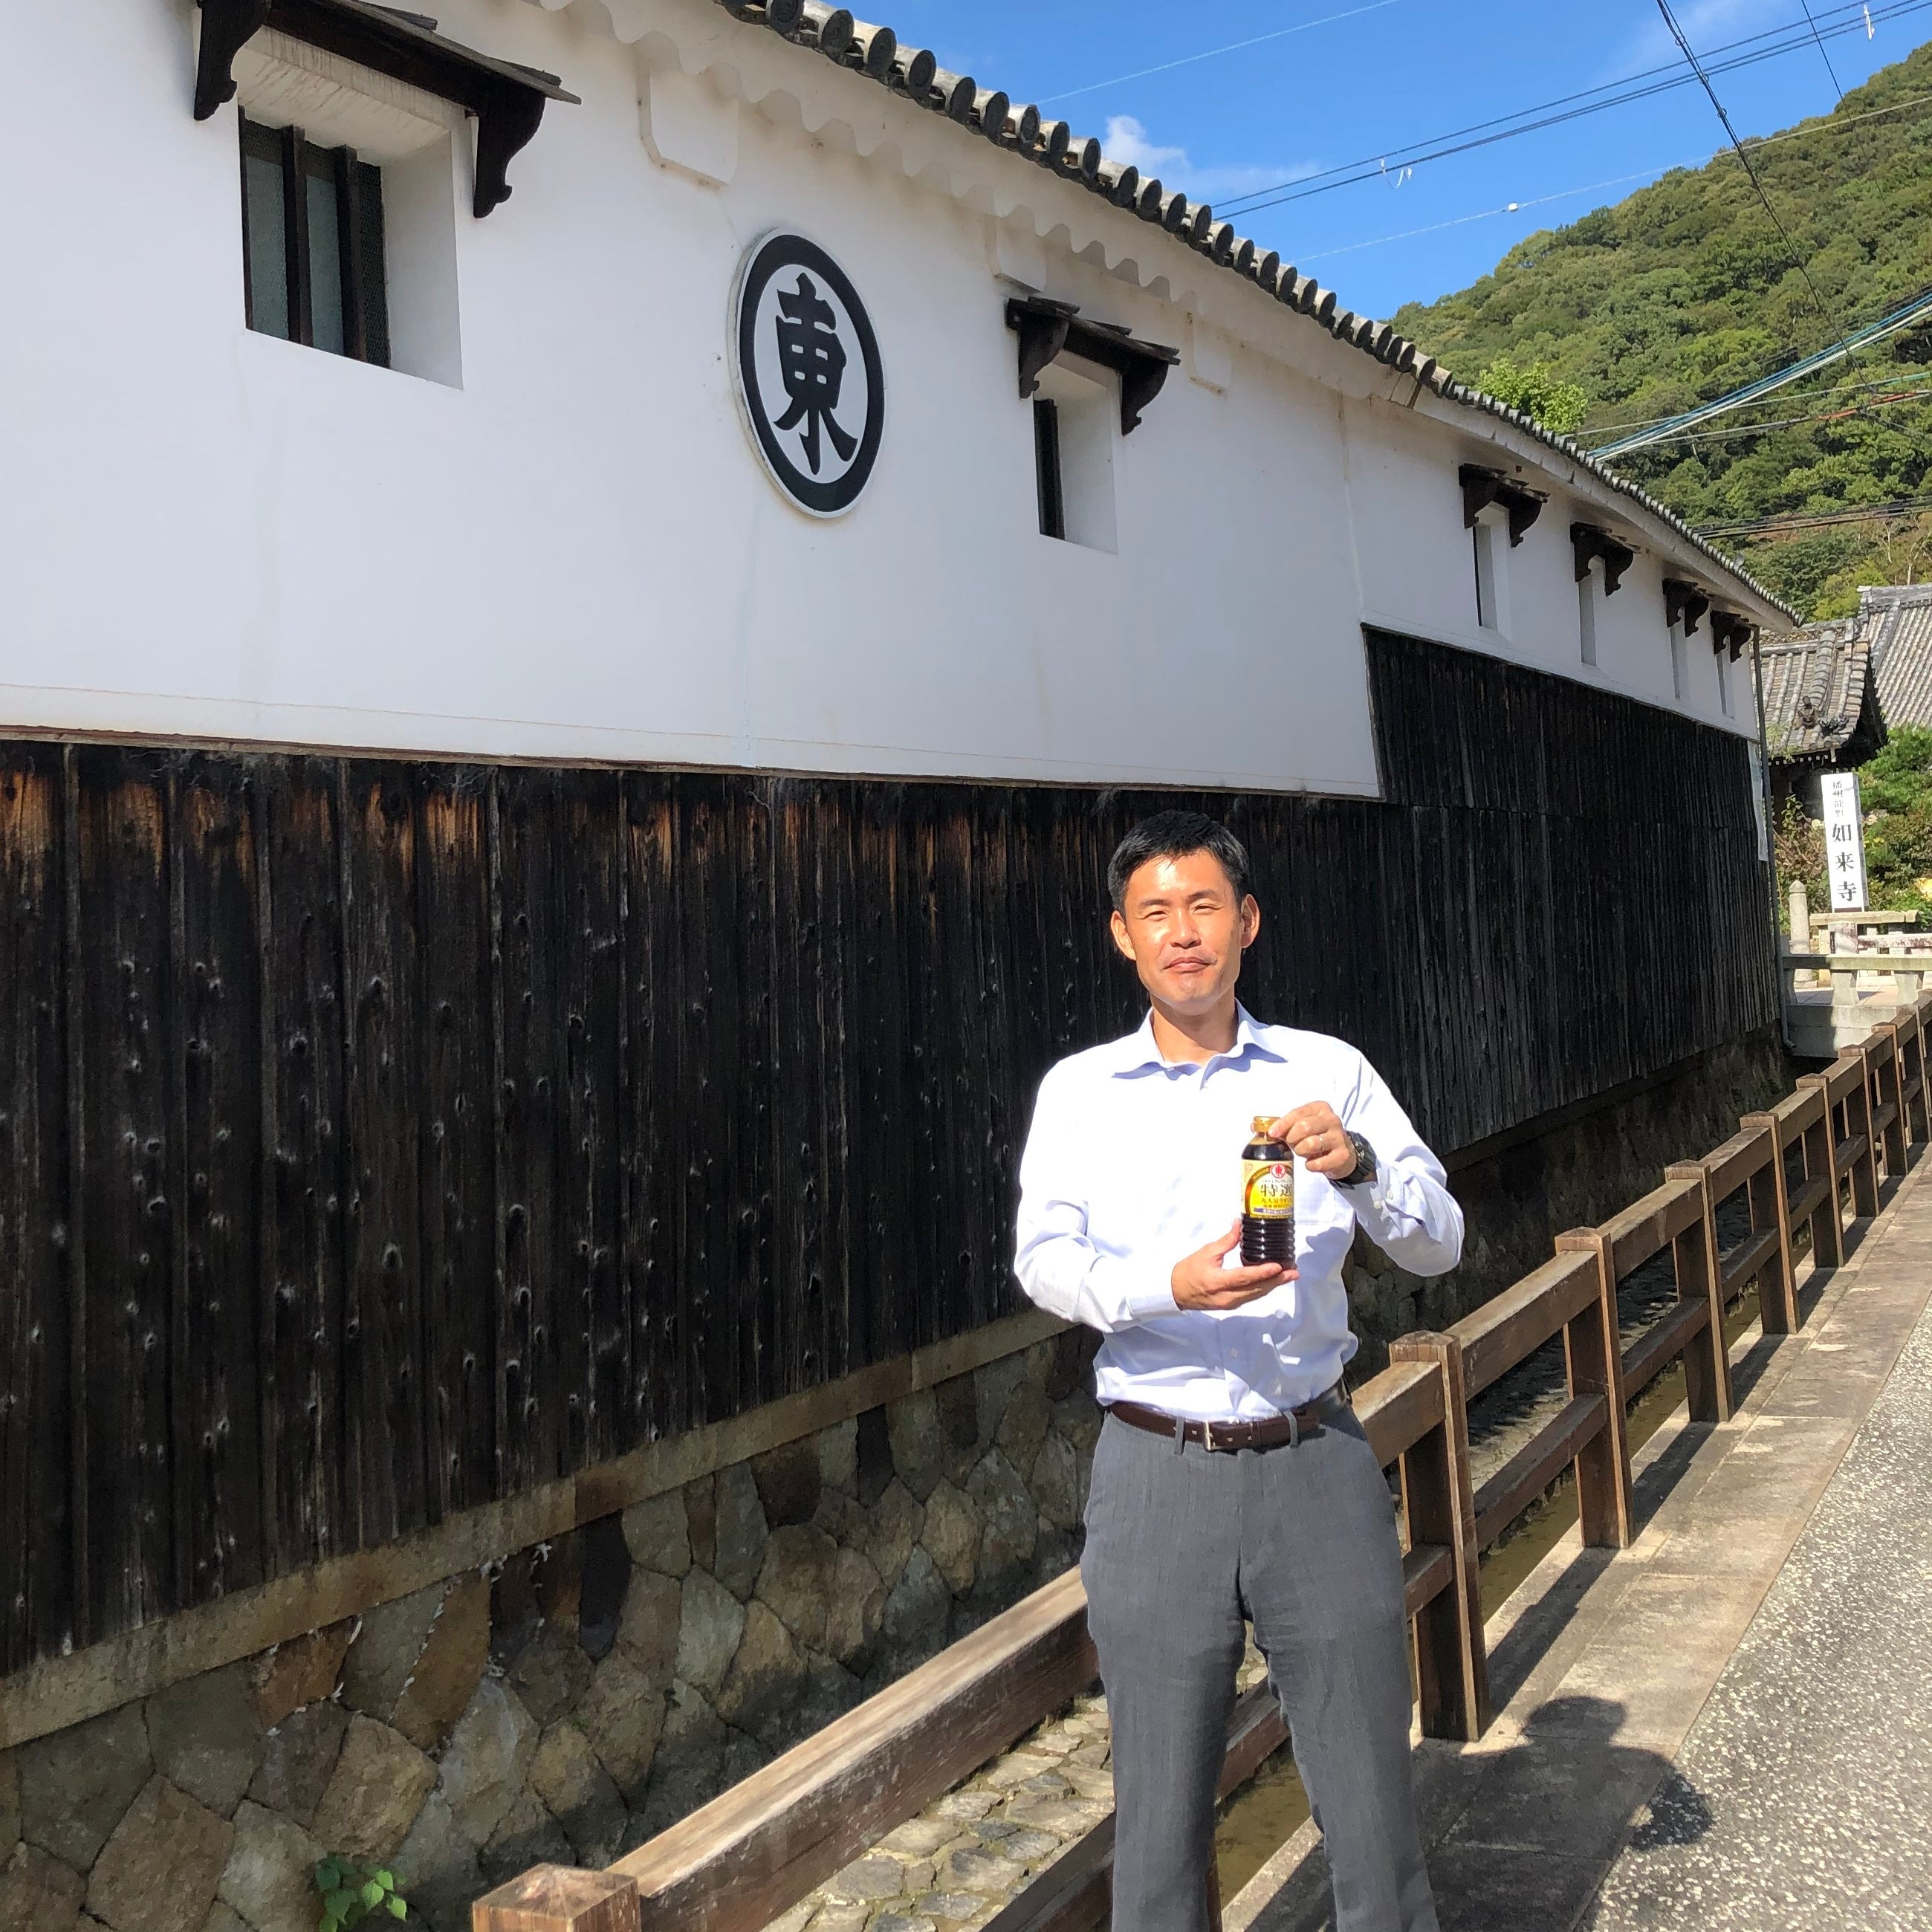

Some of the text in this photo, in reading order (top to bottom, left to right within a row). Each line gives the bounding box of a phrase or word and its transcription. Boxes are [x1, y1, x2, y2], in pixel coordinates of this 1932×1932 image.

[773, 271, 859, 476] 東
[1832, 823, 1857, 901] 如来寺
